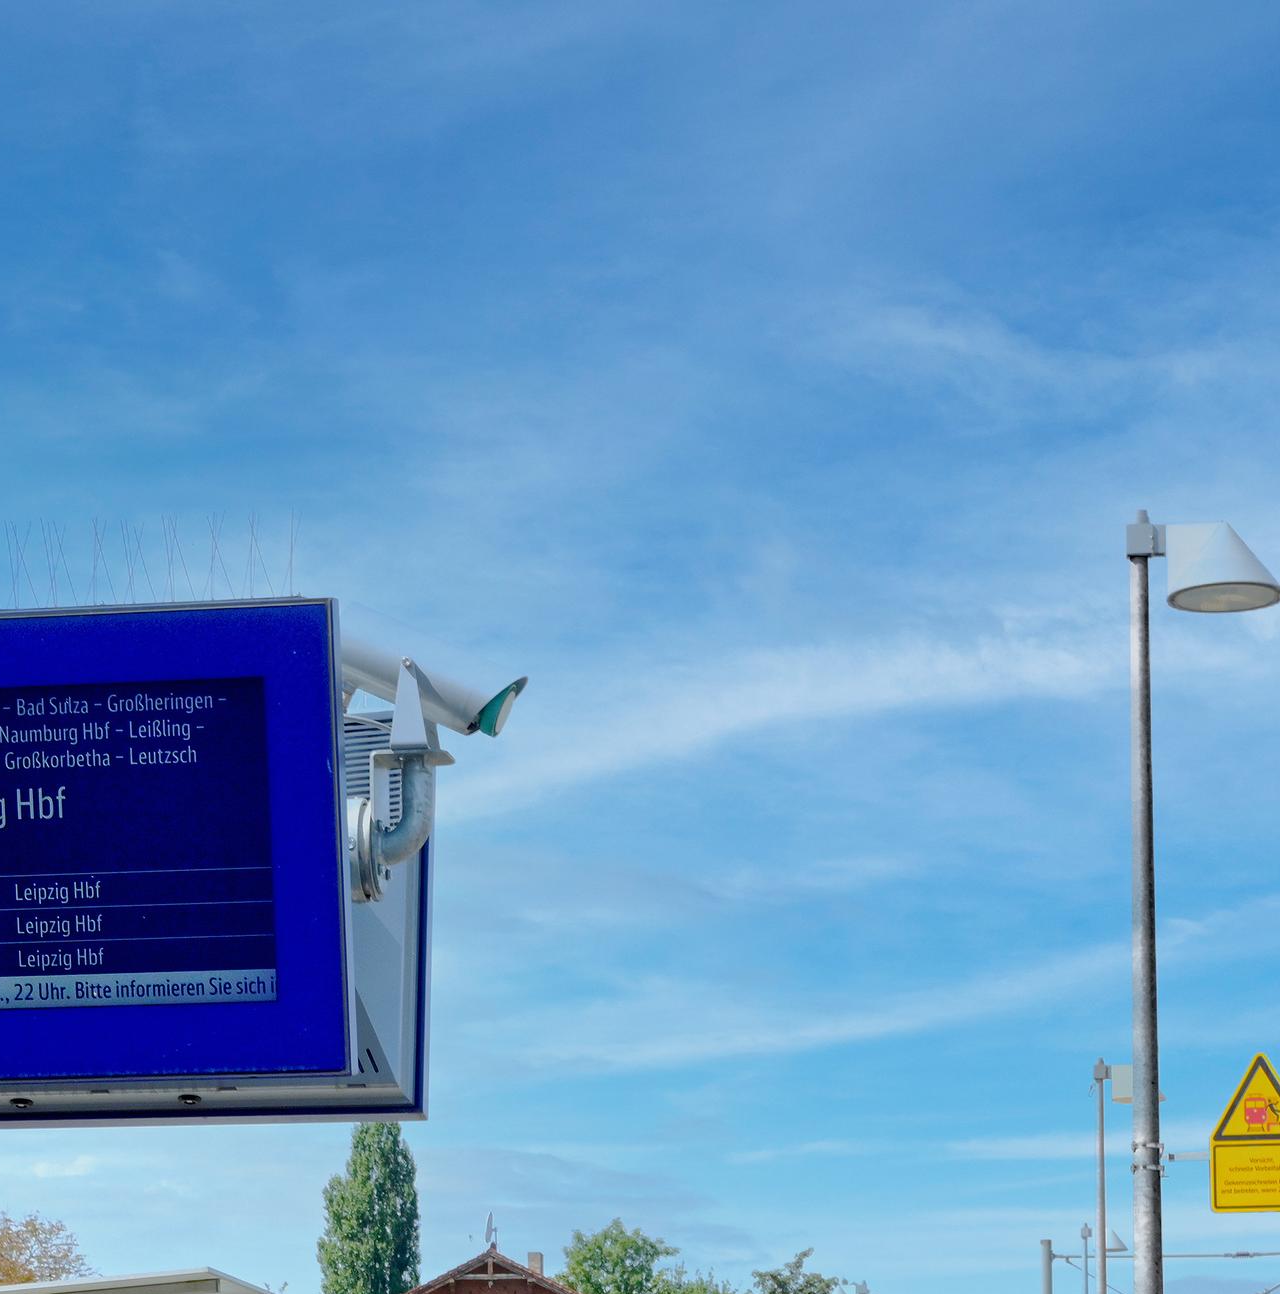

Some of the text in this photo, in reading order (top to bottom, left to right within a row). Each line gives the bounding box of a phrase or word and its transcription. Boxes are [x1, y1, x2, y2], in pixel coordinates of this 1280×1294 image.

[17, 698, 44, 716] Bad
[50, 697, 88, 714] Sulza
[108, 693, 212, 713] Großheringen
[0, 725, 77, 745] Naumburg
[83, 722, 109, 739] Hbf
[130, 720, 190, 740] Leißling
[5, 749, 110, 769] Großkorbetha
[130, 746, 196, 764] Leutzsch
[17, 786, 65, 819] Hbf
[16, 881, 100, 904] Leipzig Hbf
[17, 914, 102, 937] Leipzig Hbf
[19, 948, 103, 971] Leipzig Hbf
[15, 983, 33, 1000] 22
[39, 983, 70, 1000] Uhr.
[76, 982, 111, 999] Bitte
[116, 980, 205, 998] informieren
[209, 977, 232, 995] Sie
[236, 976, 266, 994] sich
